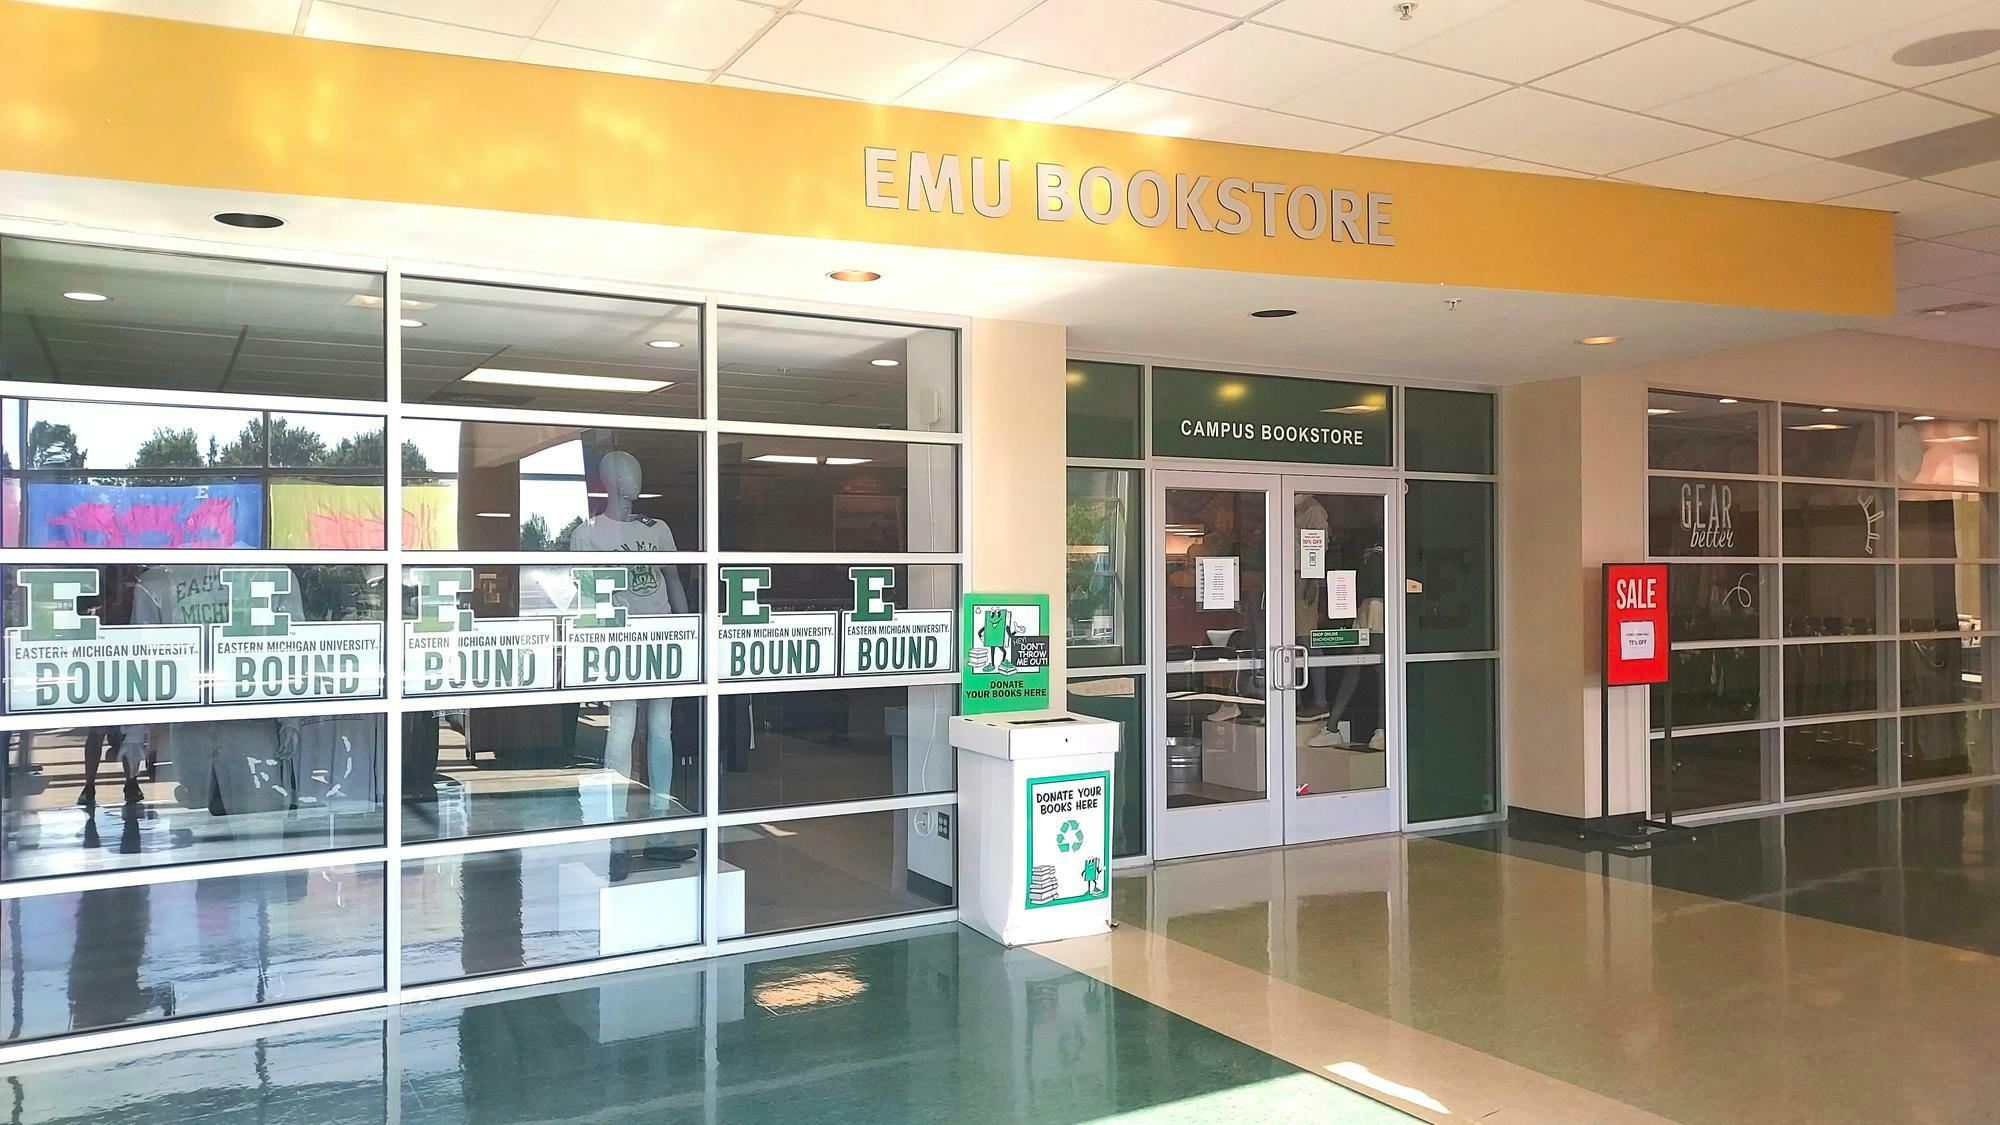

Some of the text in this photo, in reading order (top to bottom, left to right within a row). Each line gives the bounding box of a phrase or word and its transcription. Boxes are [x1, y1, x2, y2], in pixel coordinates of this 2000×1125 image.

[864, 146, 1395, 247] EMU BOOKSTORE
[1181, 419, 1364, 446] CAMPUS BOOKSTORE
[1681, 483, 1732, 529] GEAR
[1690, 522, 1734, 548] better
[1616, 578, 1657, 609] SALE
[569, 630, 696, 643] EASTERN MICHIGAN UNIVERSITY
[718, 626, 833, 639] EASTERN MICHIGAN UNIVERSITY
[847, 624, 949, 635] EASTERN MICHIGAN UNIVERSITY
[217, 639, 376, 654] EASTERN MICHIGAN UNIVERSITY
[409, 634, 550, 649] EASTERN ICHIGAN UNIVERSITY
[1020, 643, 1045, 651] DON'T
[15, 643, 195, 660] EASTERN MICHIGAN UNIVERSITY
[731, 638, 821, 677] BOUND
[858, 635, 938, 672] BOUND
[1018, 650, 1048, 658] THROW
[424, 648, 536, 691] BOUND
[583, 643, 682, 683] BOUND
[1016, 658, 1028, 666] ME
[36, 660, 177, 706] BOUND
[235, 653, 359, 698] BOUND
[990, 680, 1024, 689] DONATE
[966, 688, 1047, 699] YOUR BOOKS HERE
[1036, 785, 1102, 804] DONATE YOUR
[1040, 798, 1098, 815] BOOKS HERE
